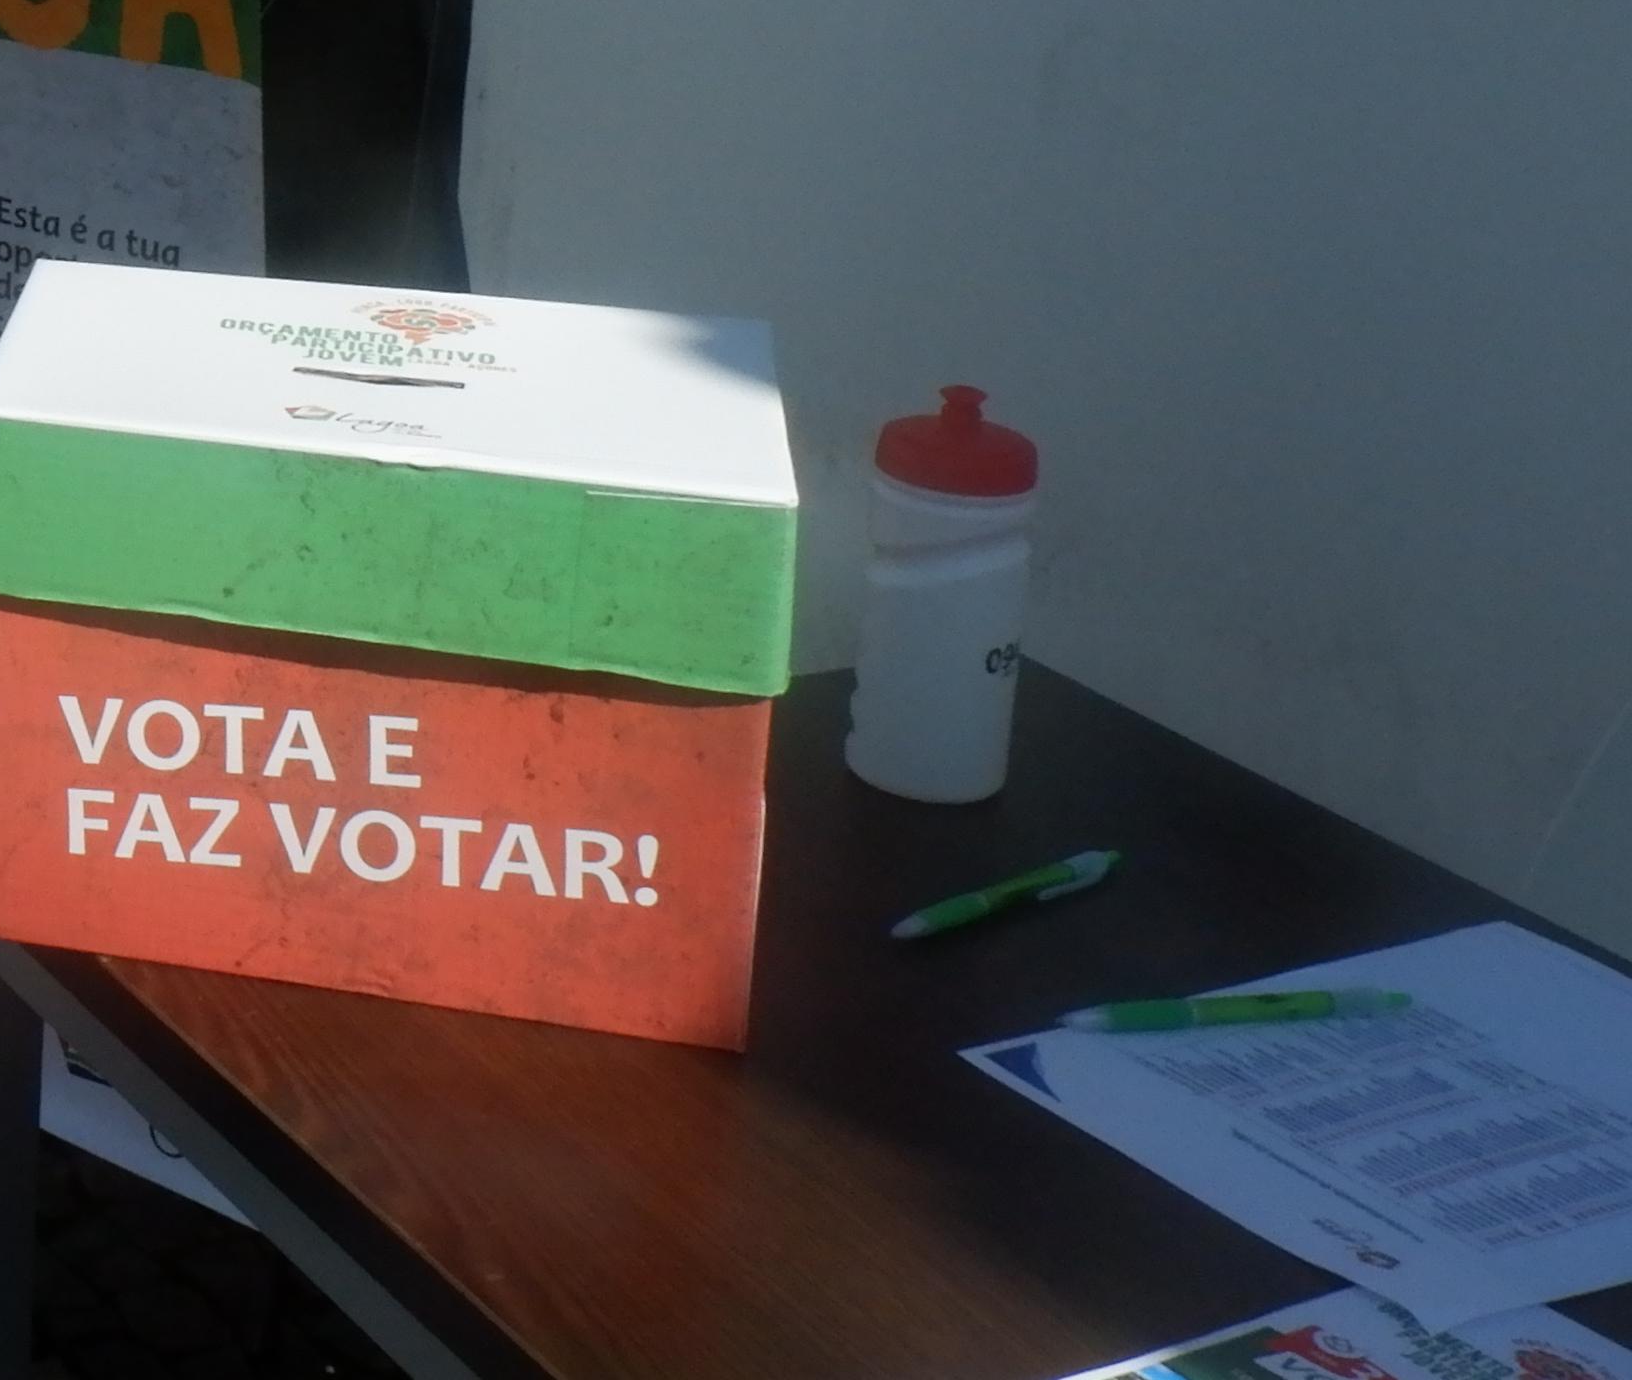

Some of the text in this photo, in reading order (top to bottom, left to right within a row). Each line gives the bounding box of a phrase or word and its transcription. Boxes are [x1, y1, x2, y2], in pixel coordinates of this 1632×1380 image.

[70, 214, 88, 244] é
[97, 228, 116, 251] a
[126, 229, 181, 267] tua
[220, 317, 398, 345] ORÇAMENTO
[270, 333, 496, 365] PARTICIPATIVO
[302, 347, 403, 367] JOVEM
[335, 412, 425, 433] Lagoa
[59, 694, 422, 788] VOTA E
[66, 788, 660, 907] FAZ VOTAR!
